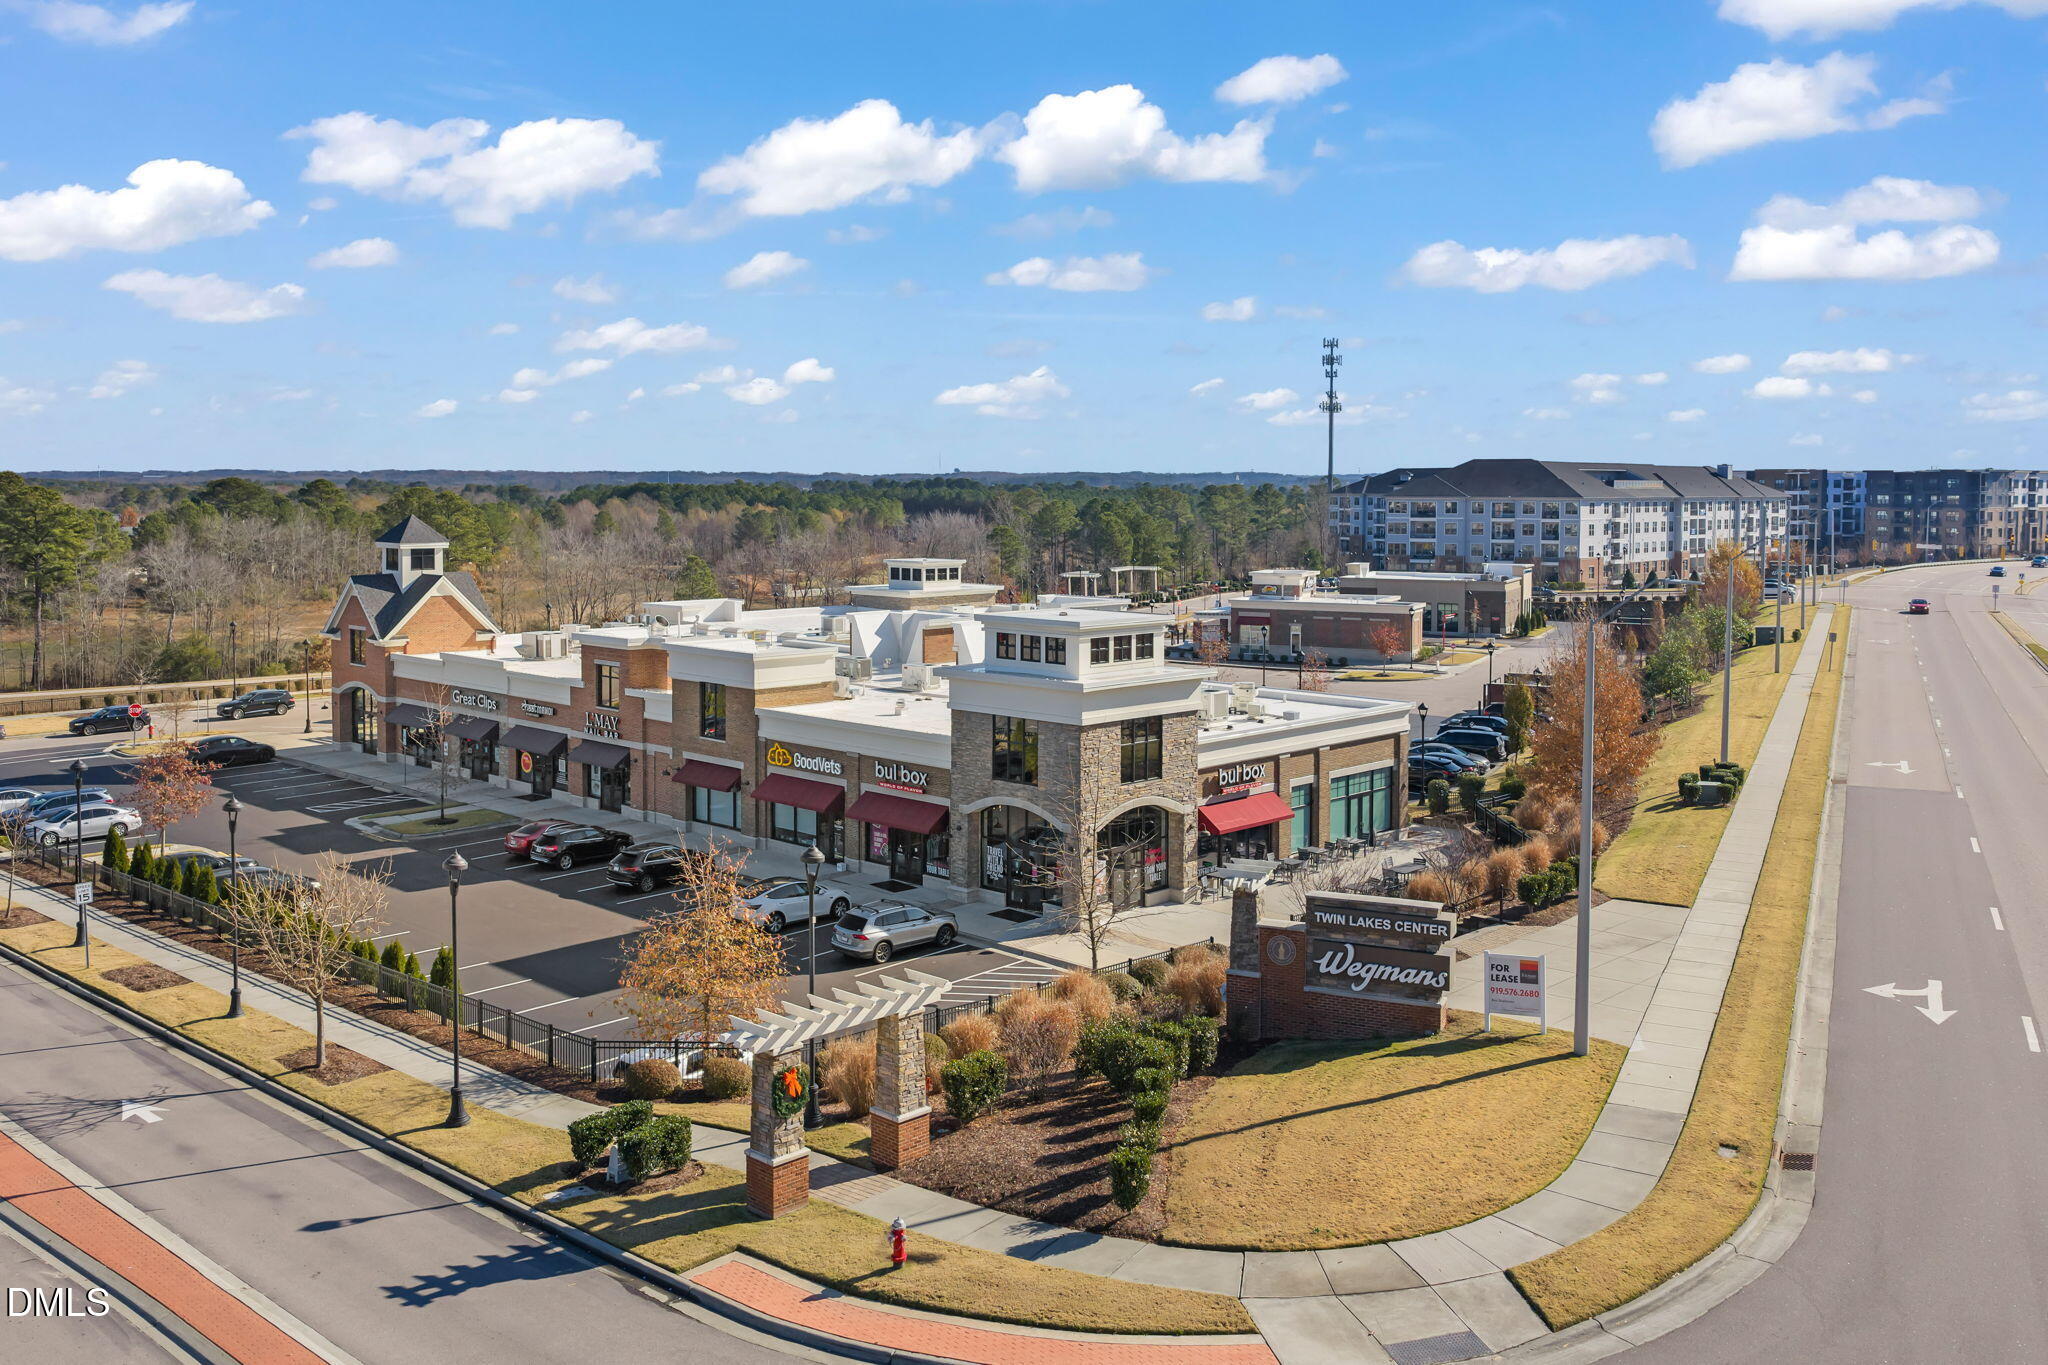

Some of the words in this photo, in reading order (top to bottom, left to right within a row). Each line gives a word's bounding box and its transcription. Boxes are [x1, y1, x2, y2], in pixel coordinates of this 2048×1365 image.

[452, 690, 476, 706] Great
[477, 694, 497, 712] Clips
[585, 711, 619, 731] L'MAY
[584, 726, 601, 737] NAIL
[604, 730, 619, 740] BAR
[793, 752, 842, 775] GoodVets
[875, 761, 897, 781] bul
[900, 766, 928, 786] box
[1219, 765, 1239, 785] bul
[1243, 764, 1266, 781] box
[987, 845, 1004, 857] TRAVEL
[987, 854, 999, 864] WITH
[987, 862, 1004, 874] FRIEND
[79, 893, 90, 902] 15
[1314, 911, 1346, 925] TWIN
[1349, 915, 1392, 931] LAKES
[1394, 920, 1448, 937] CENTER
[1313, 943, 1448, 992] Wegmans
[1490, 963, 1510, 973] FOR
[1490, 973, 1519, 984] LEASE
[1490, 986, 1540, 998] 919.576.2680
